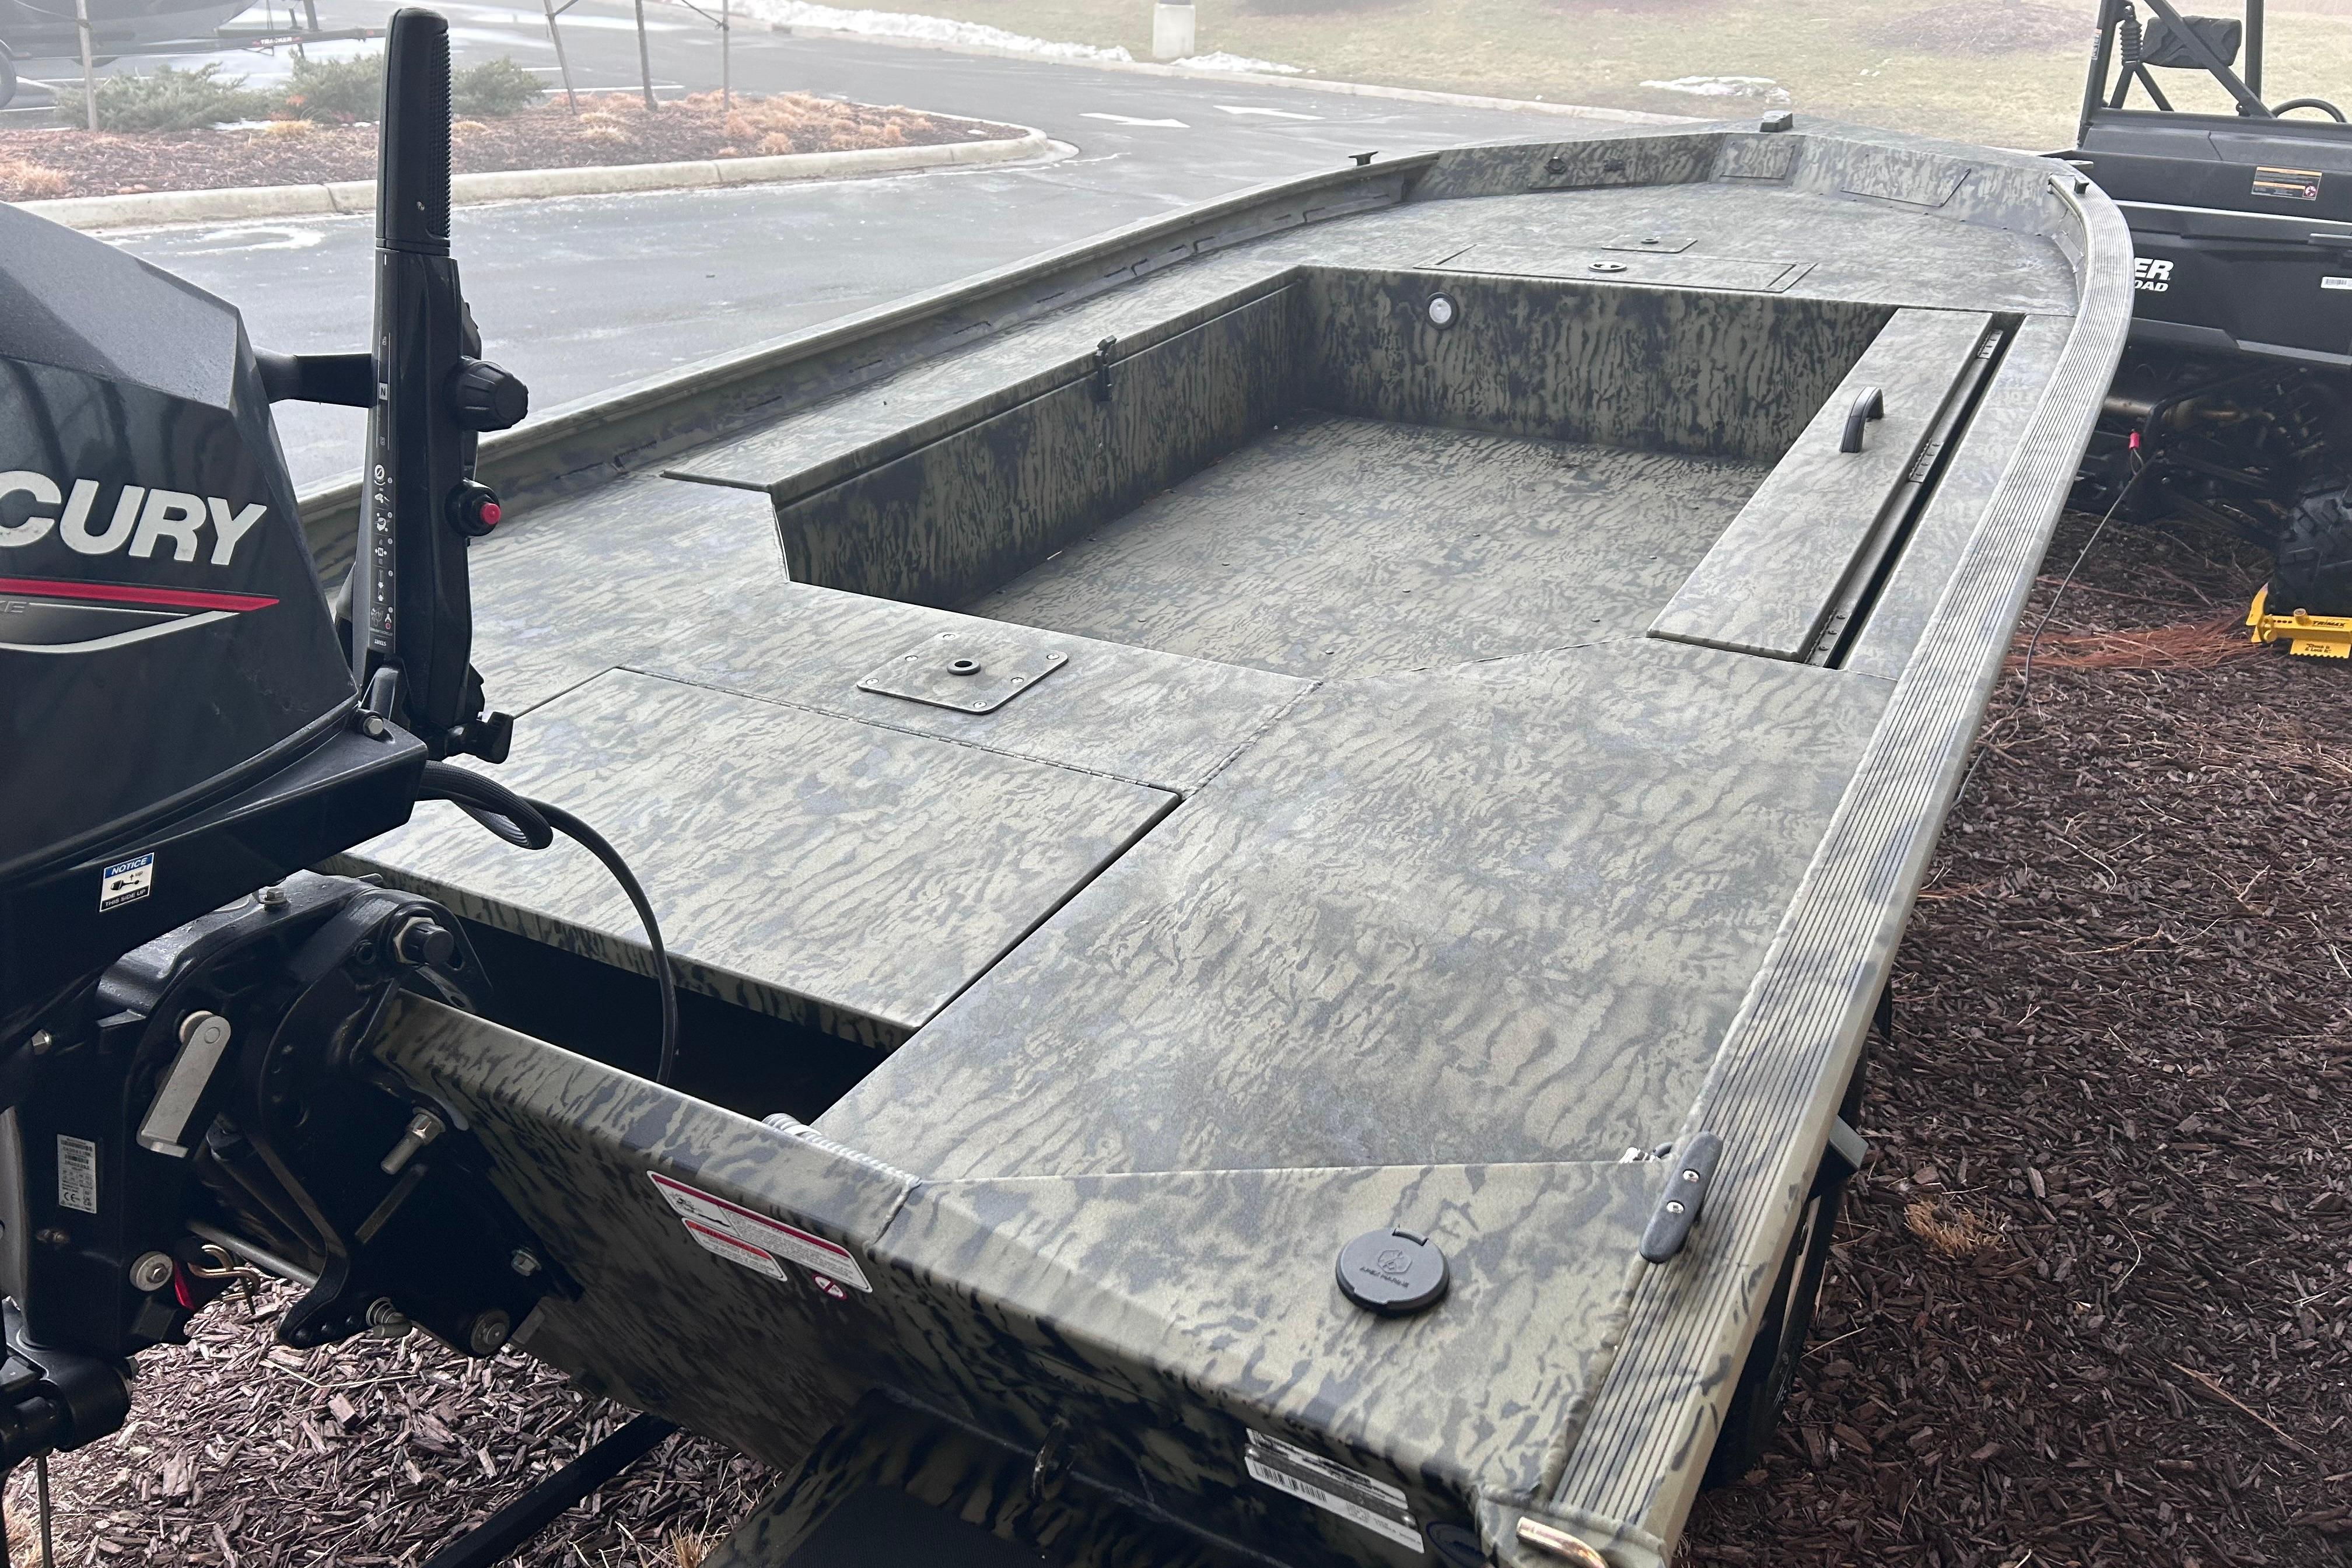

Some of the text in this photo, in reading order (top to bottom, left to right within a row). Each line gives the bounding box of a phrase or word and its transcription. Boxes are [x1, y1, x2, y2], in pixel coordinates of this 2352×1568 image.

[2134, 257, 2174, 280] ER
[380, 387, 386, 396] N
[111, 857, 148, 875] NOTICE
[106, 898, 120, 907] THIS
[121, 892, 136, 902] SIDE
